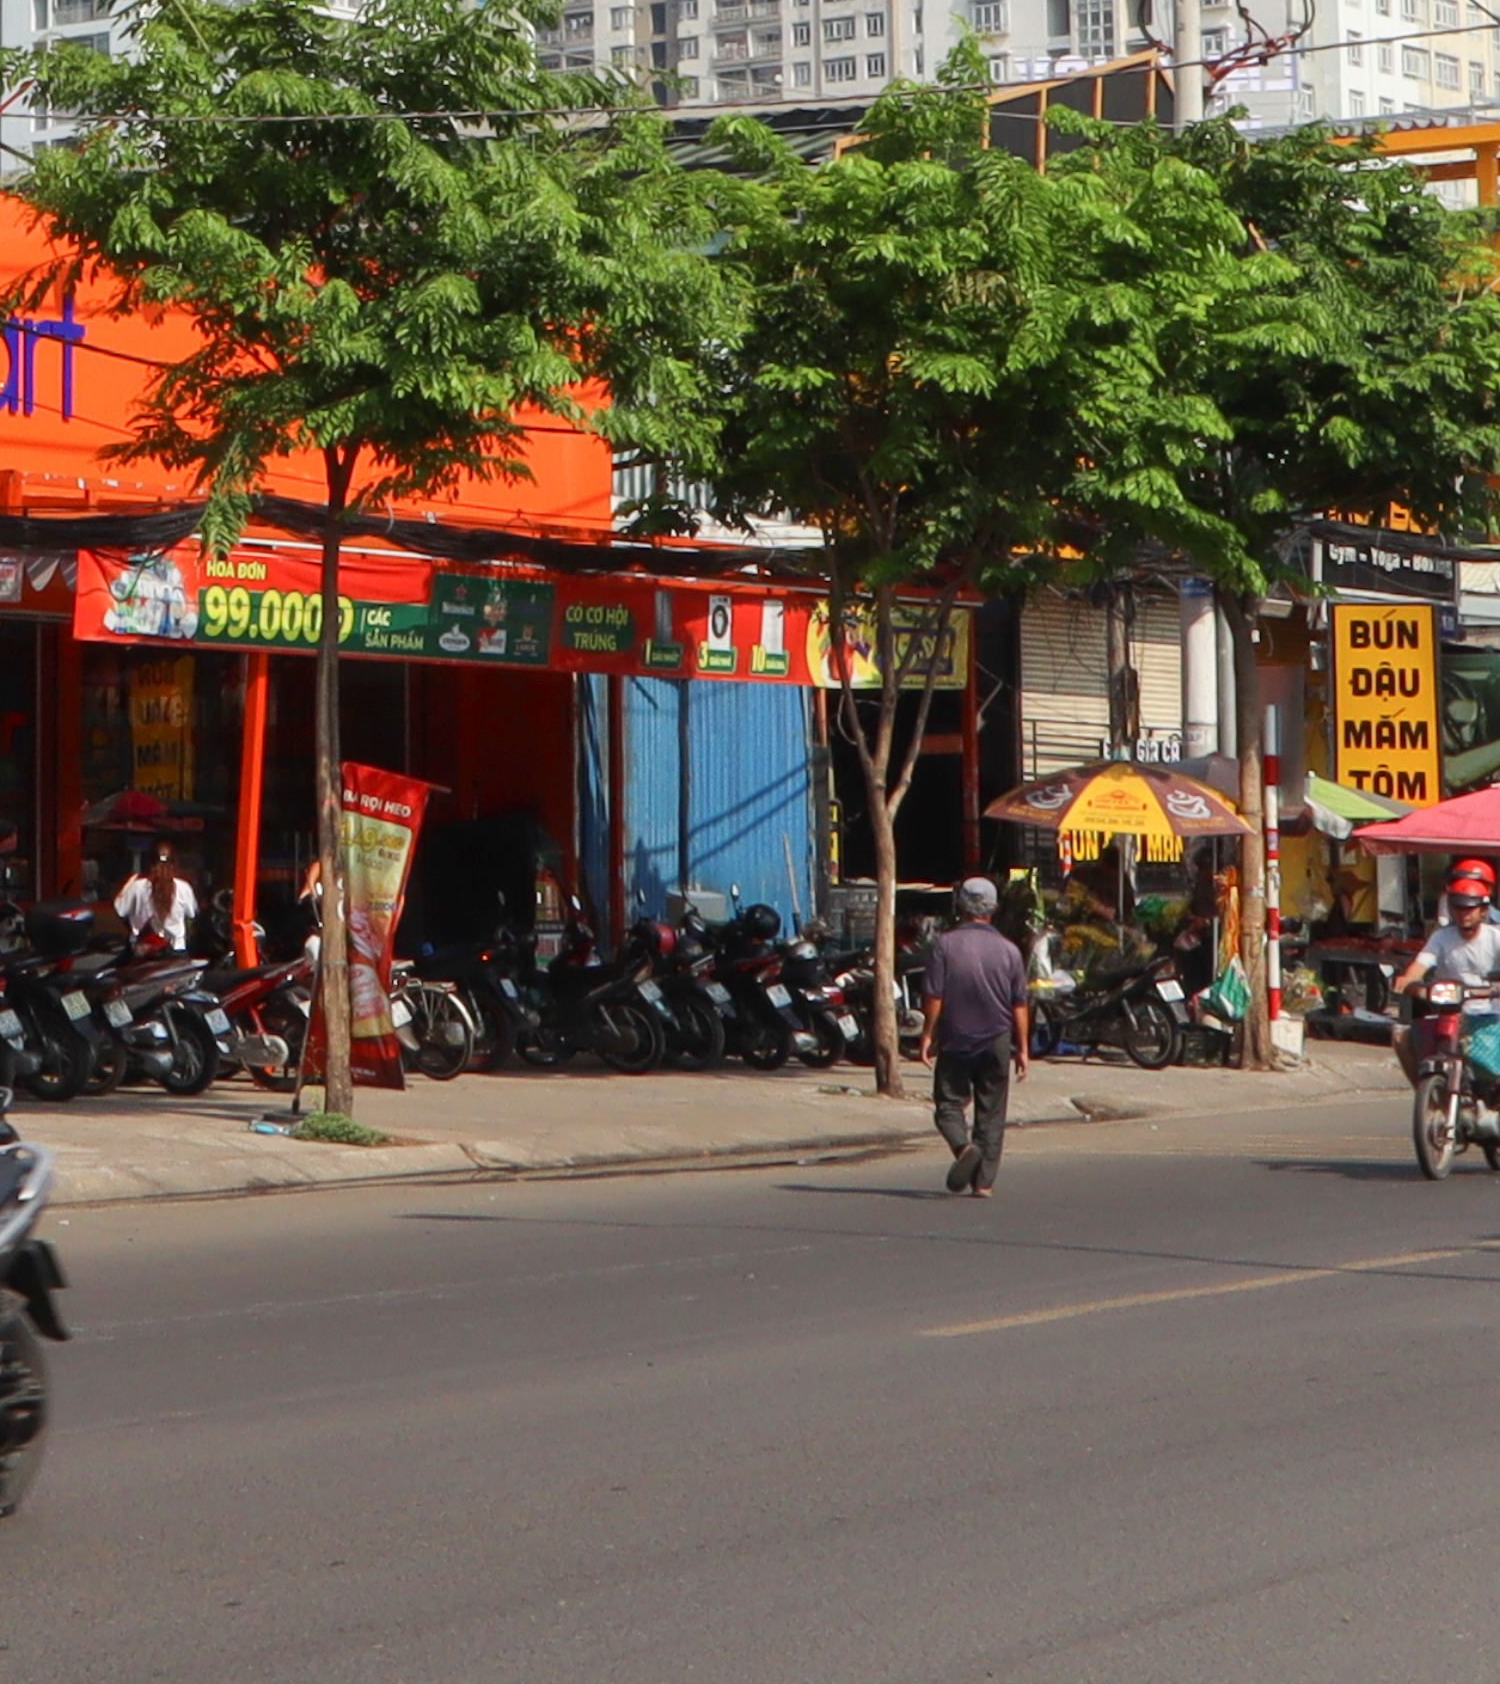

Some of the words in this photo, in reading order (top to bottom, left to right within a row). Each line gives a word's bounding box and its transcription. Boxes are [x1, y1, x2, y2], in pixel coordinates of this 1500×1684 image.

[367, 606, 392, 627] CÁC
[1349, 608, 1420, 650] BÚN
[698, 641, 709, 669] 3
[751, 644, 767, 672] 10
[1348, 661, 1421, 702] ĐẬU
[1343, 706, 1429, 750] MẮM
[1347, 764, 1427, 801] TÔM
[384, 800, 412, 818] HEO
